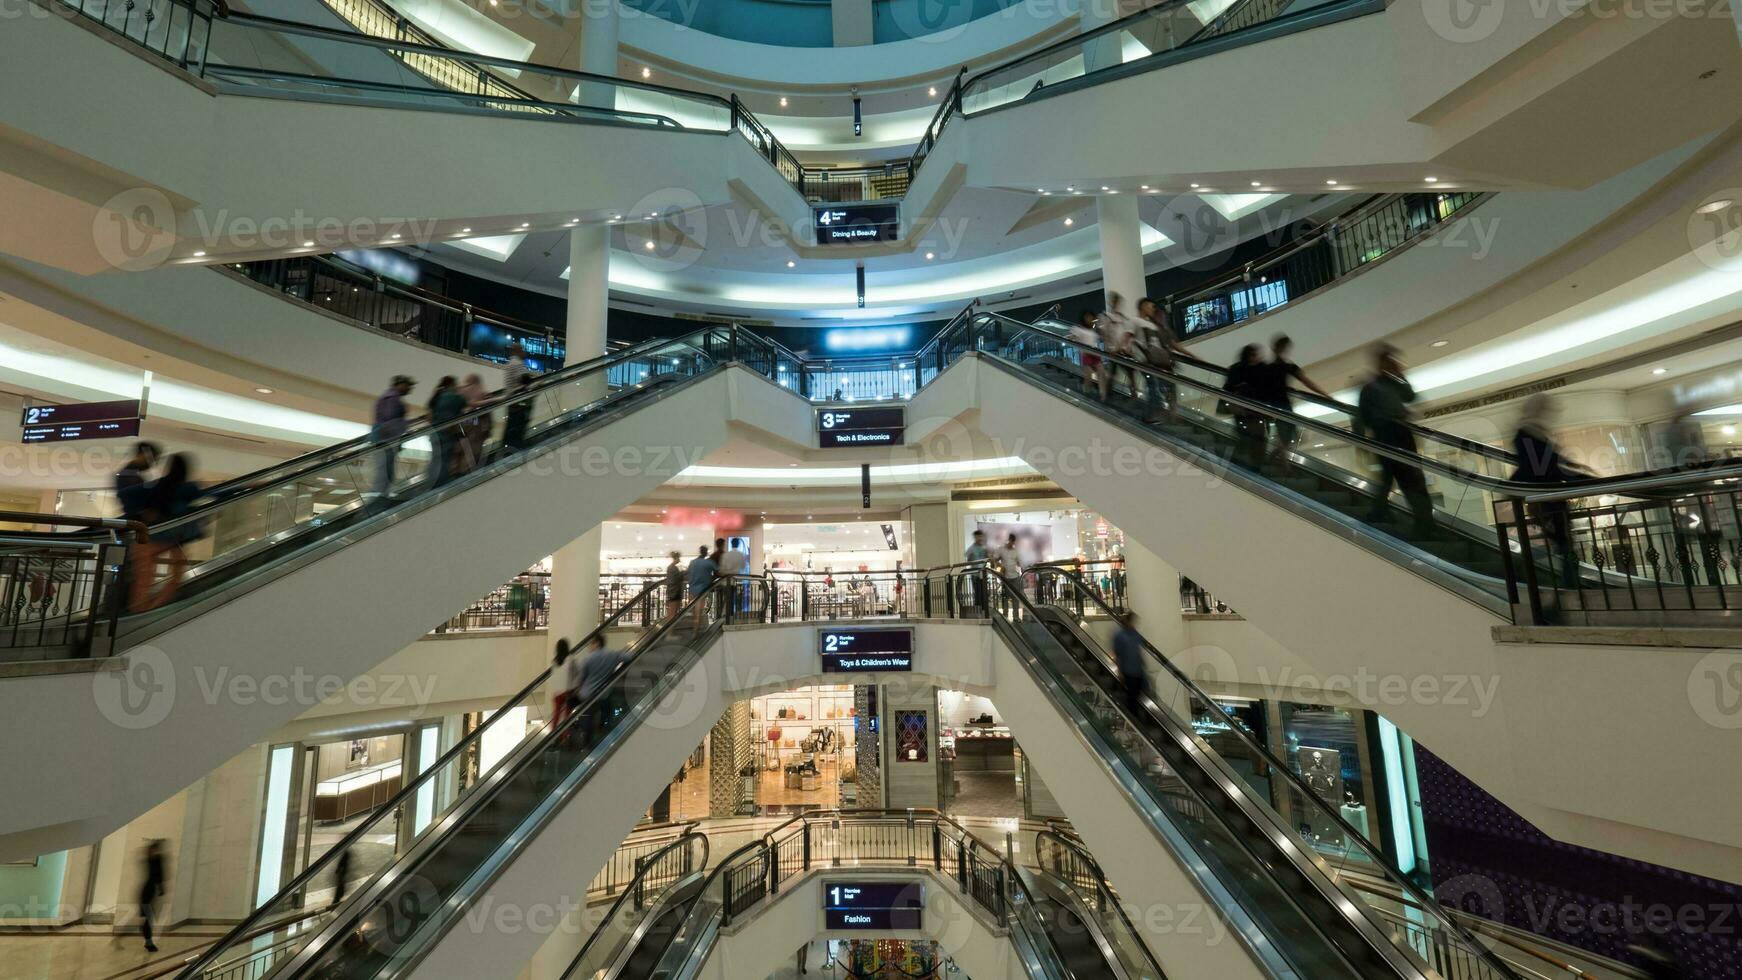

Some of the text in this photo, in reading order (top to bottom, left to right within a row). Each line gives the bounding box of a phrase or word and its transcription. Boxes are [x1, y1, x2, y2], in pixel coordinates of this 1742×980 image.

[820, 211, 831, 225] 4
[832, 231, 851, 239] Dining
[857, 229, 877, 238] Beauty
[27, 408, 40, 423] 2
[823, 413, 834, 428] 3
[836, 434, 851, 442] Tech
[858, 433, 890, 442] Electronics
[826, 635, 838, 651] 2
[840, 658, 909, 668] Toys & Children's Wear
[831, 887, 840, 905] 1
[844, 915, 871, 924] Fashion
